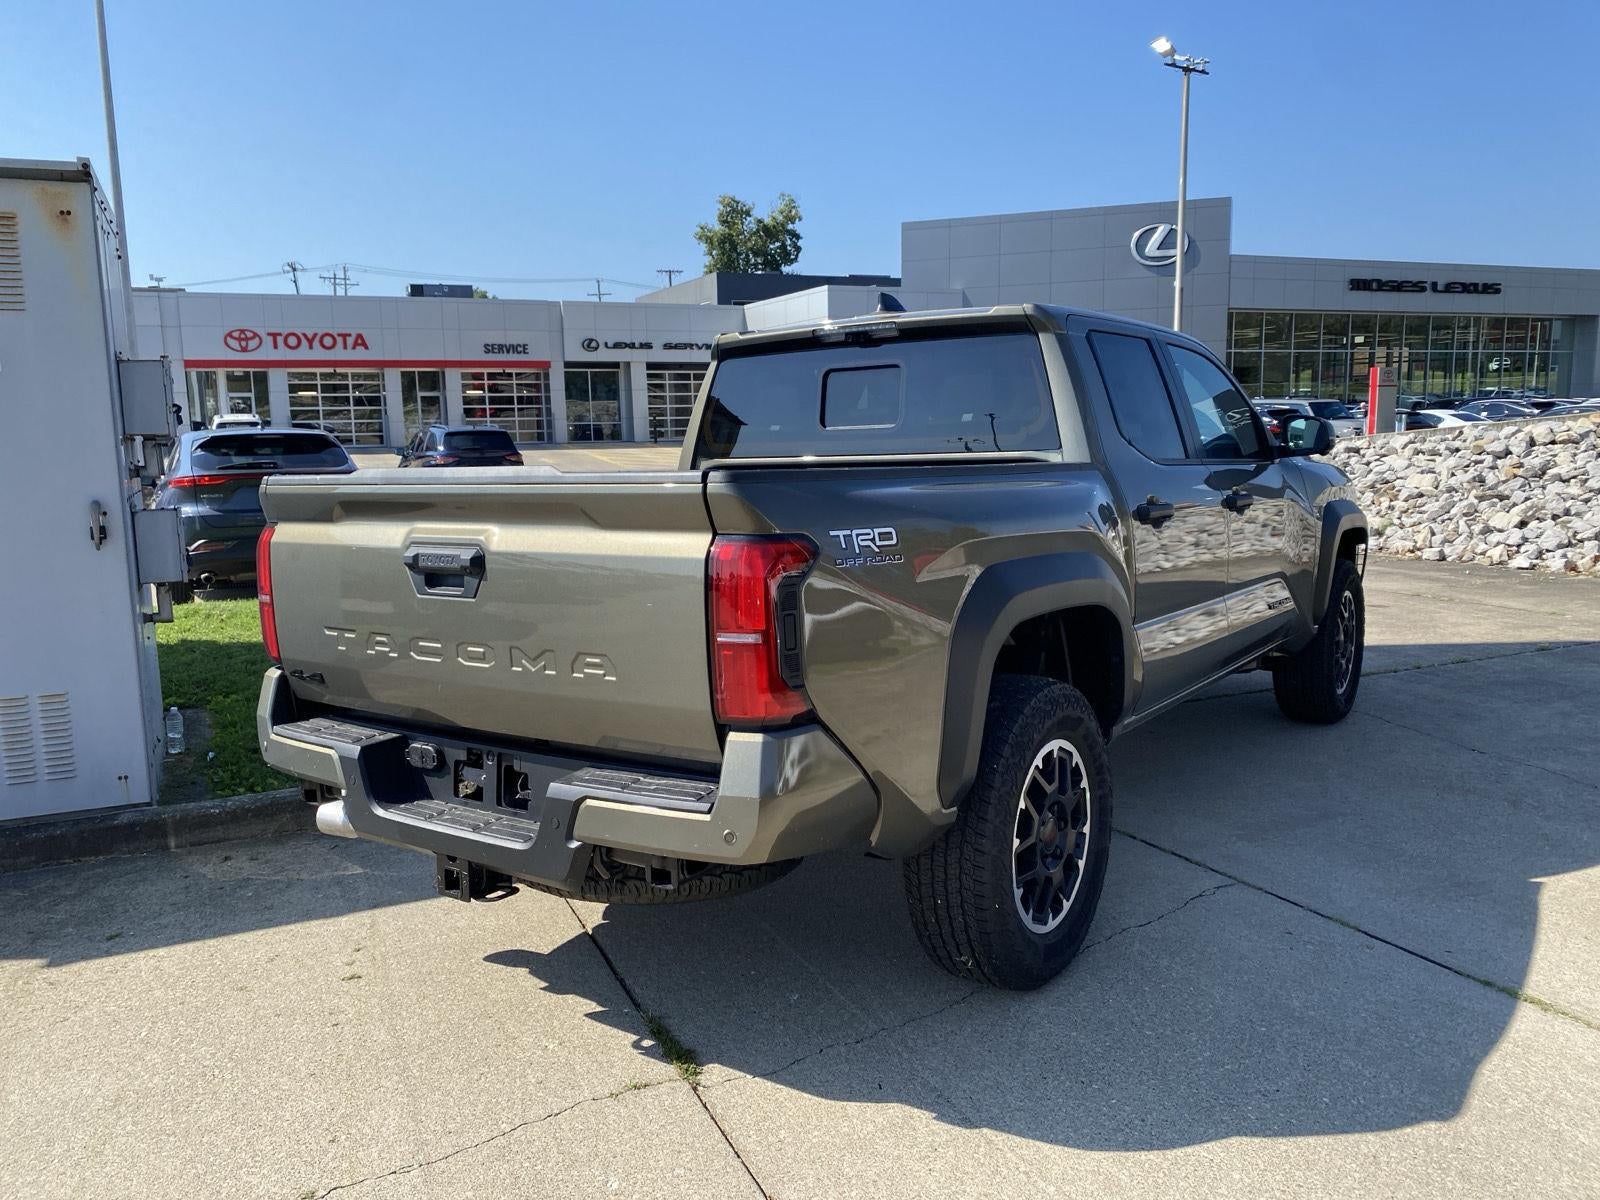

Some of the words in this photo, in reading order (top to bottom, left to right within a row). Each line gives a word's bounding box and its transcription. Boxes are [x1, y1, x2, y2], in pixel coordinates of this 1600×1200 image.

[1349, 278, 1427, 293] MOSES
[1431, 281, 1502, 294] LEXUS
[267, 332, 369, 350] TOYOTA
[605, 341, 653, 350] LEXUS
[662, 342, 712, 350] SERVI
[483, 343, 529, 355] SERVICE
[828, 527, 898, 554] TRD
[420, 554, 458, 567] TOYOTA
[835, 557, 863, 568] OFF
[867, 554, 904, 566] ROAD
[324, 626, 617, 681] TACOMA
